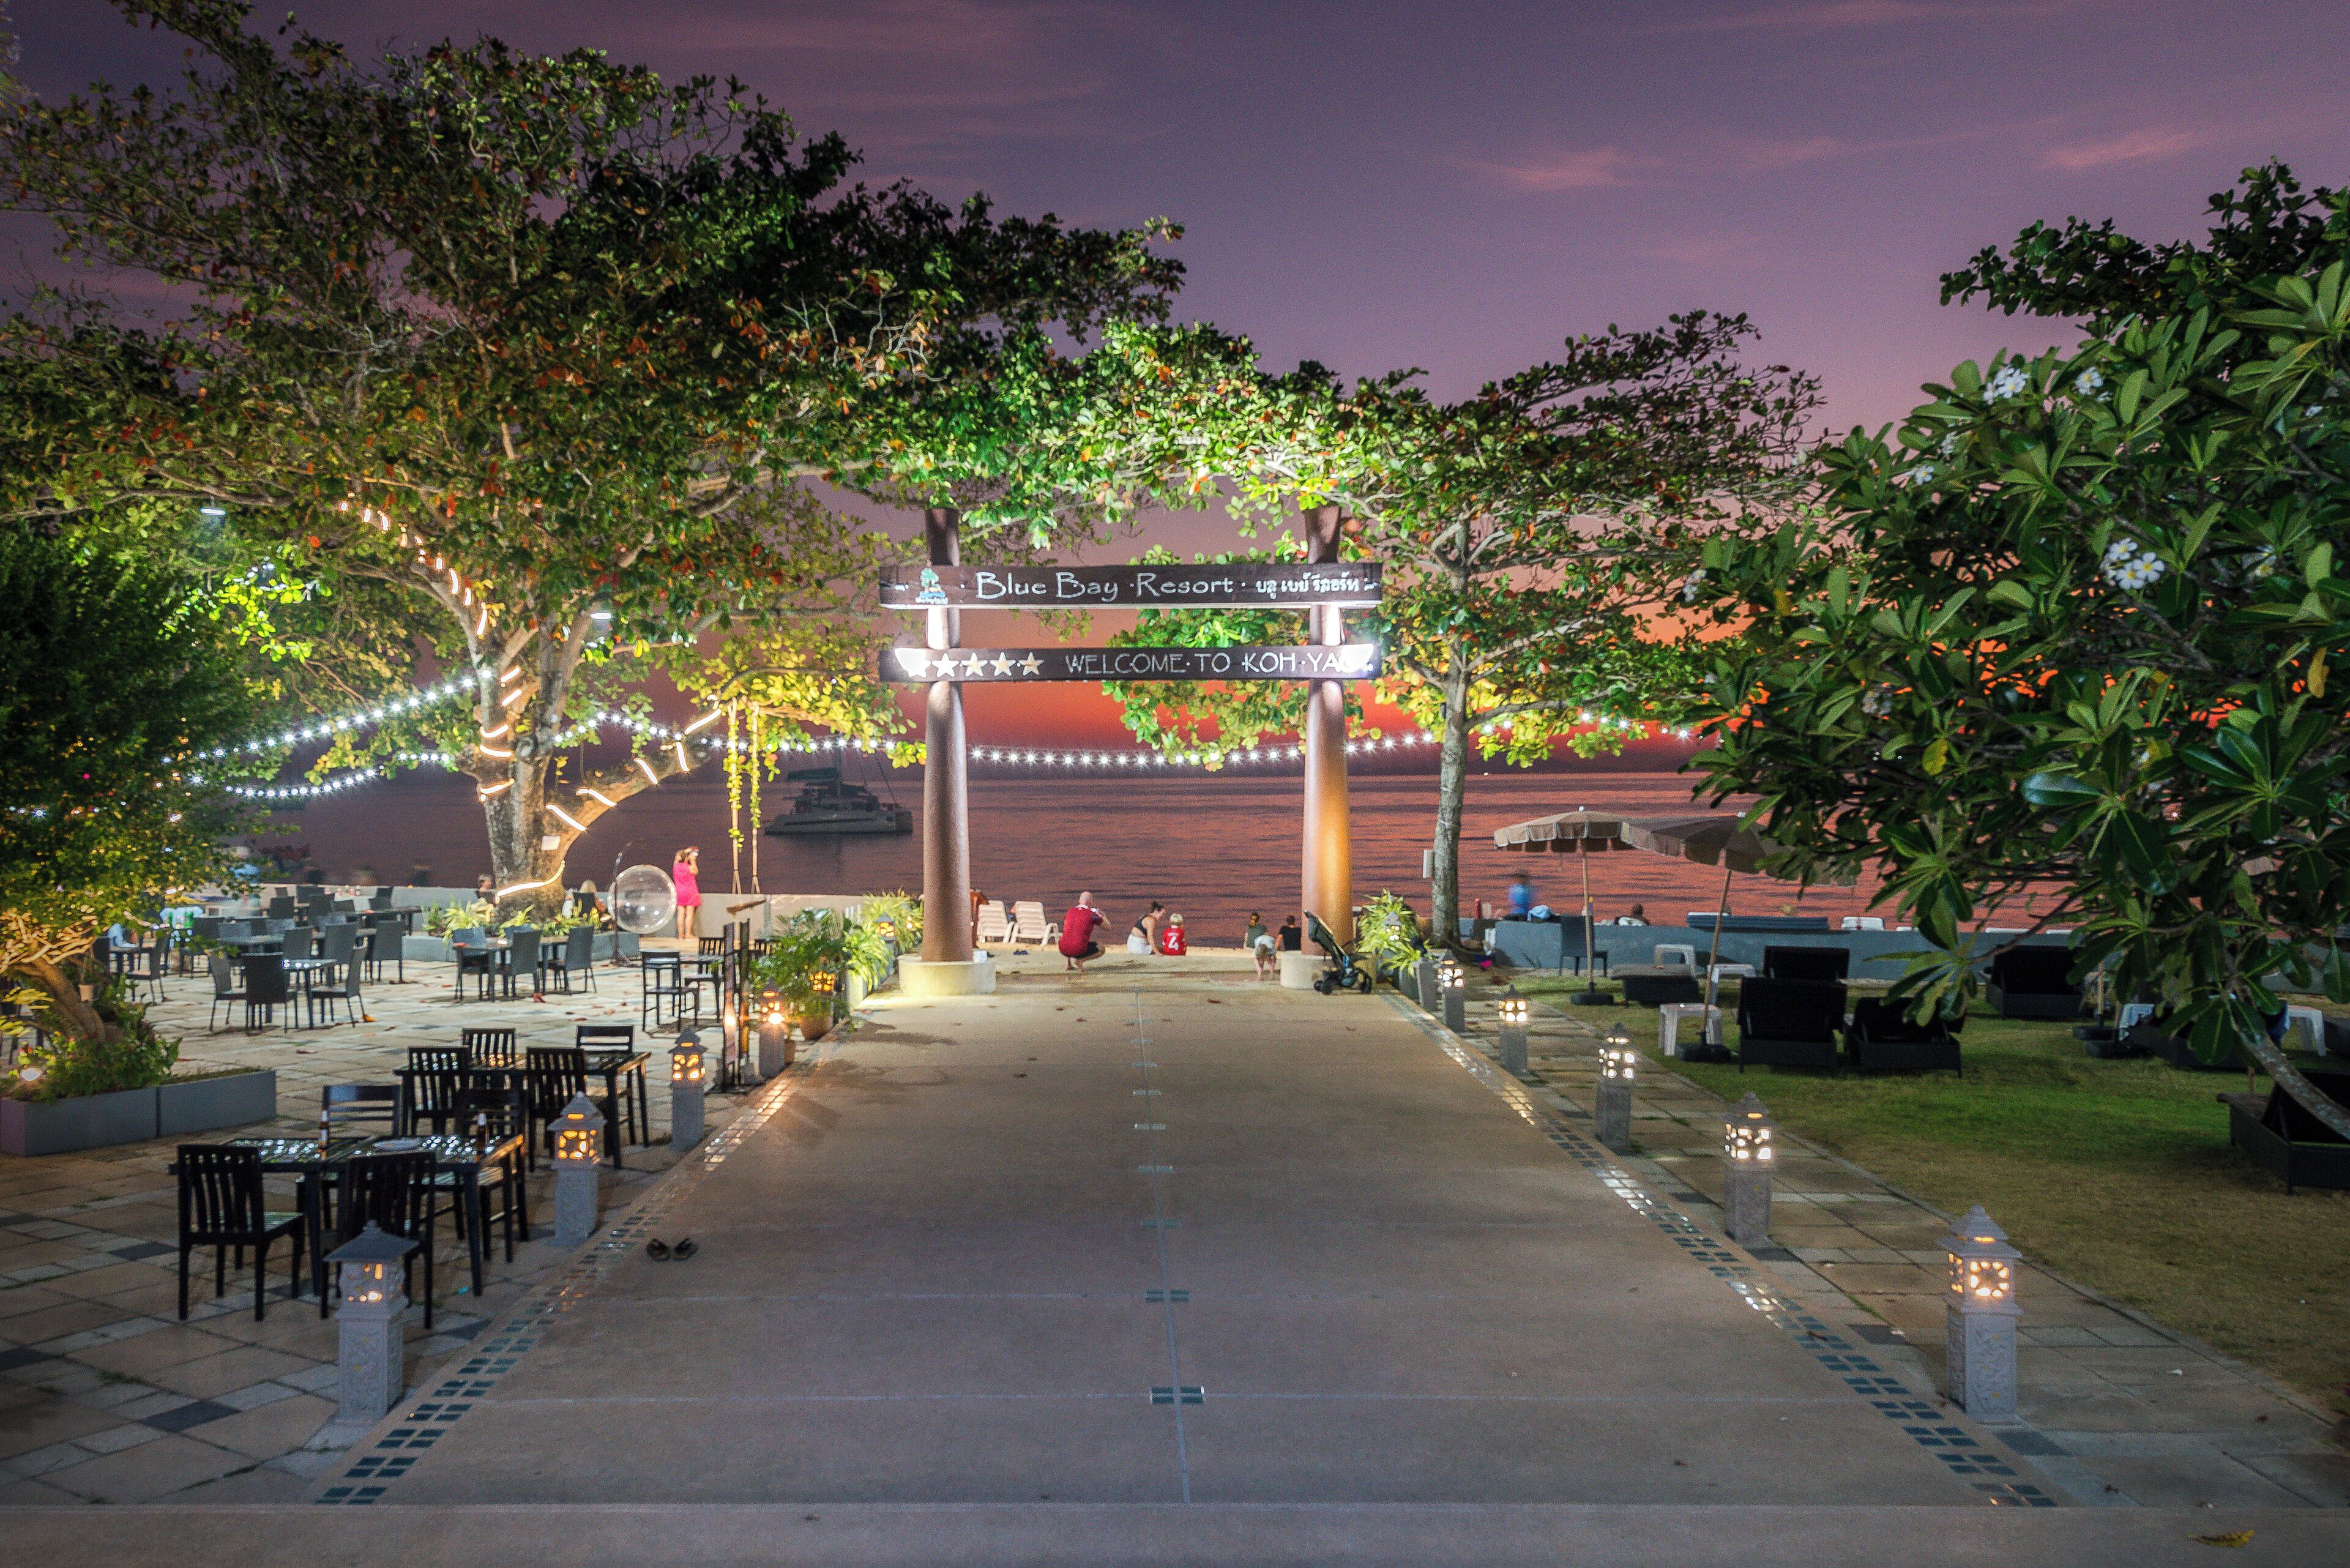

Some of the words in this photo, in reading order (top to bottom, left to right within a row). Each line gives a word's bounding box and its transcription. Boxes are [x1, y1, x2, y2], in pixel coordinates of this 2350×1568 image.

[976, 572, 1047, 599] Blue
[1056, 572, 1118, 602] Bay
[1136, 572, 1233, 597] Resort
[1065, 653, 1186, 674] WELCOME
[1194, 652, 1231, 673] TO
[1244, 652, 1296, 673] KOH
